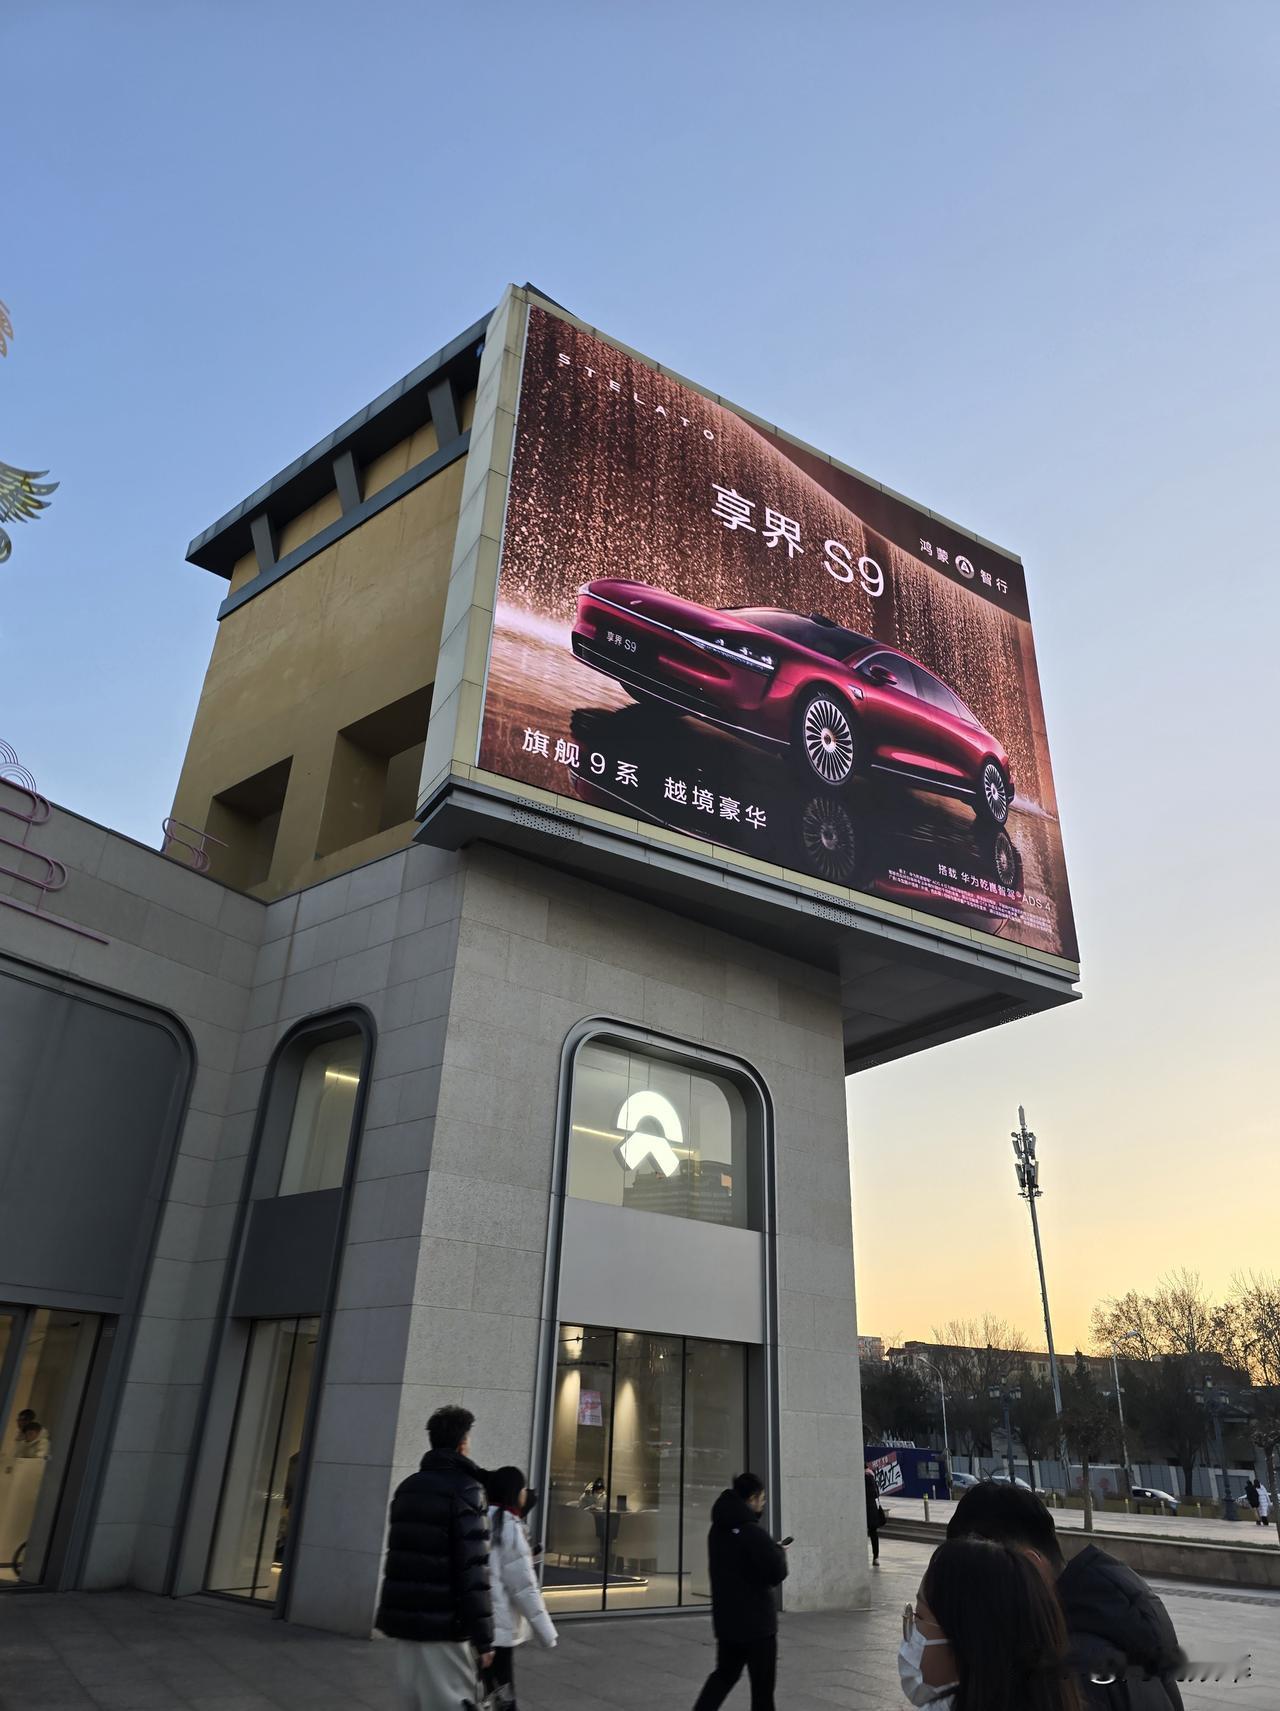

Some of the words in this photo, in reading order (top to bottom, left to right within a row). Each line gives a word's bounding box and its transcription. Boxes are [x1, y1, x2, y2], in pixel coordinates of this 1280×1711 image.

[558, 352, 714, 440] STELATO
[711, 483, 805, 559] 享界
[824, 539, 885, 598] S9
[624, 638, 637, 653] S9
[663, 776, 767, 830] 越境豪华
